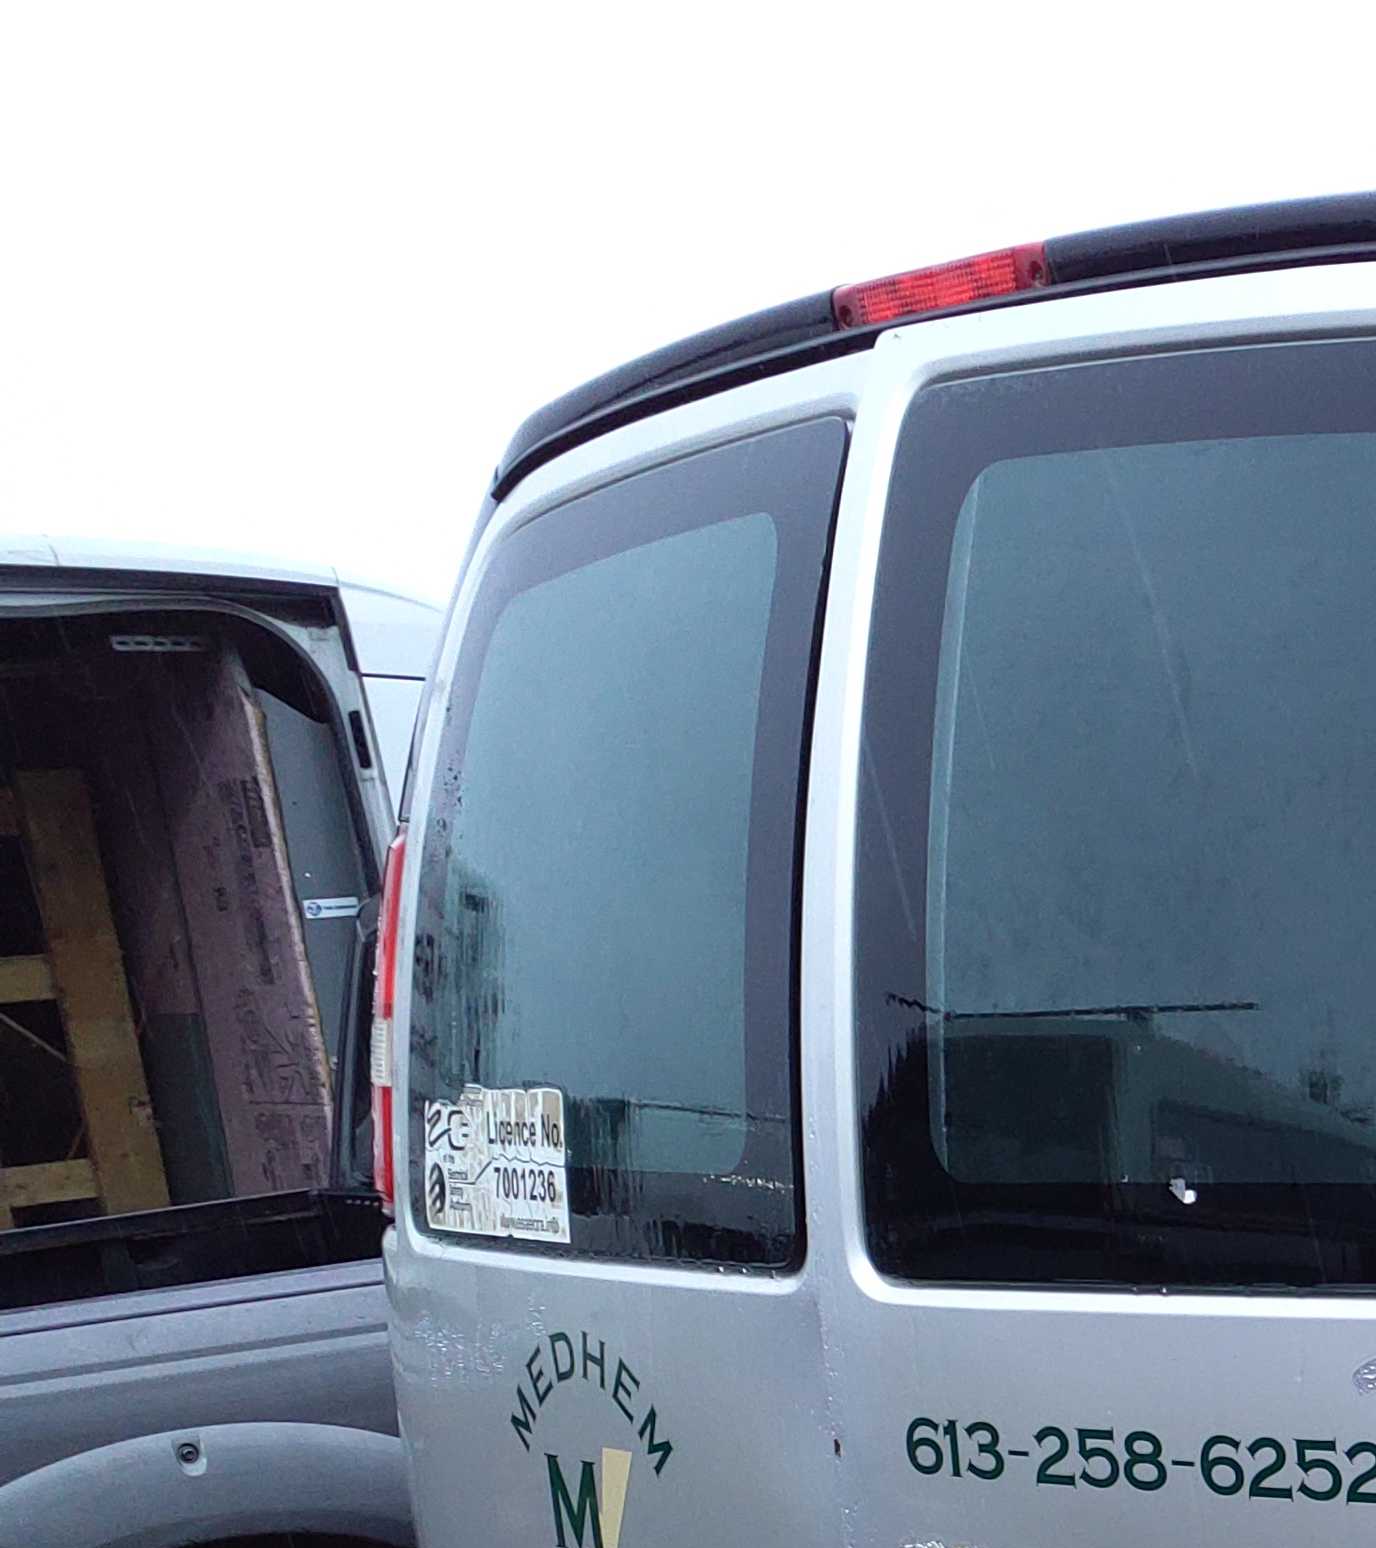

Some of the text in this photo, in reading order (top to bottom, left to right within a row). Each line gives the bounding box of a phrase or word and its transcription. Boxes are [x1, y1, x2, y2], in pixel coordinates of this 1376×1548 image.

[486, 1111, 537, 1147] Licence
[540, 1113, 563, 1149] No.
[494, 1166, 557, 1202] 7001236
[509, 1330, 674, 1478] MEDHEM
